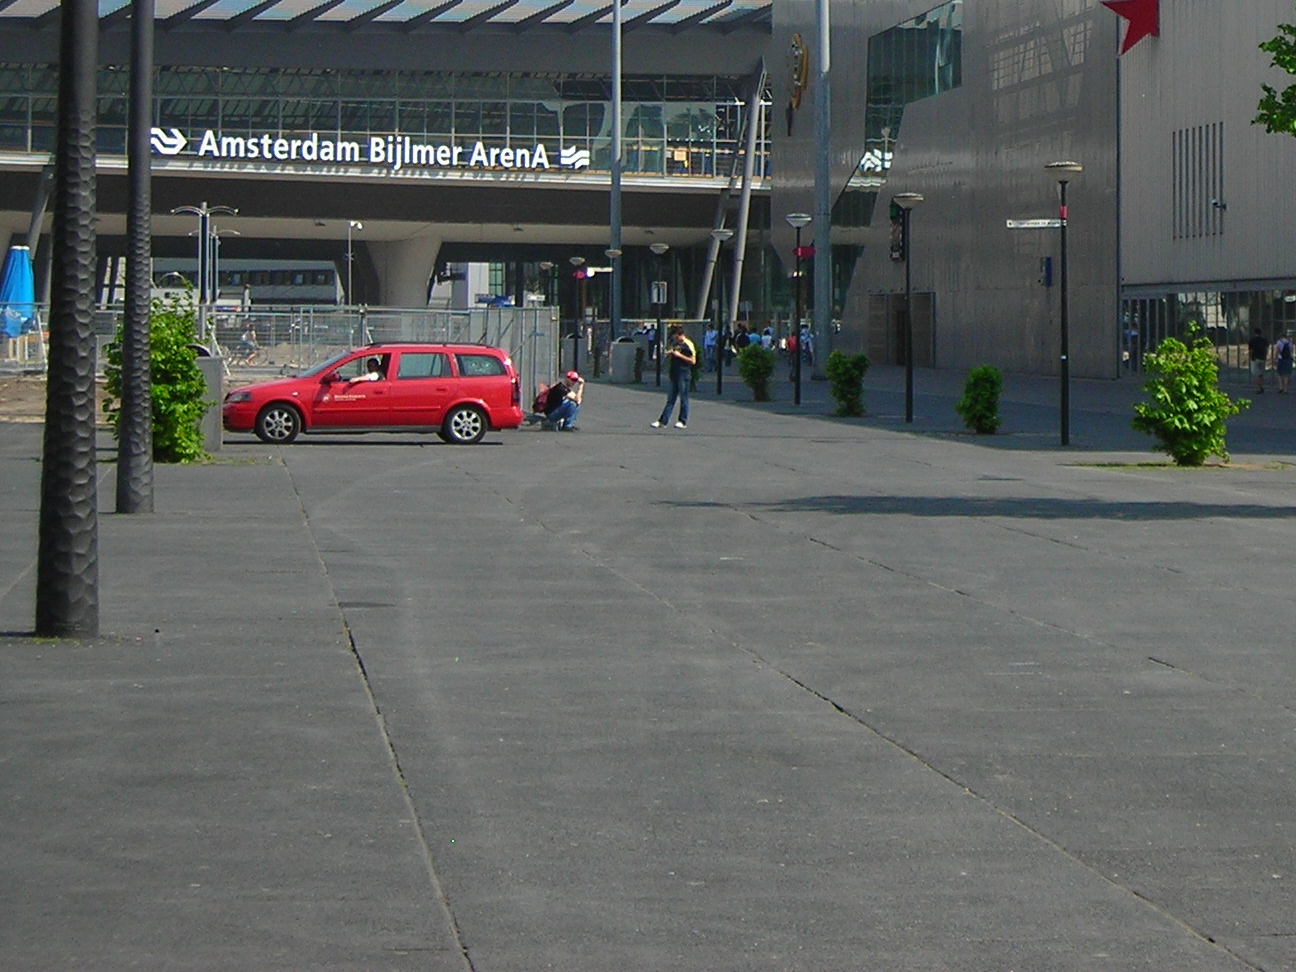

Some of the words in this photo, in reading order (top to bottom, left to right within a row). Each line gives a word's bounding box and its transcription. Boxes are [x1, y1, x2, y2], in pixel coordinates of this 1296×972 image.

[198, 129, 360, 162] Amsterdam
[369, 136, 463, 170] Bijlmer
[470, 141, 550, 169] ArenA
